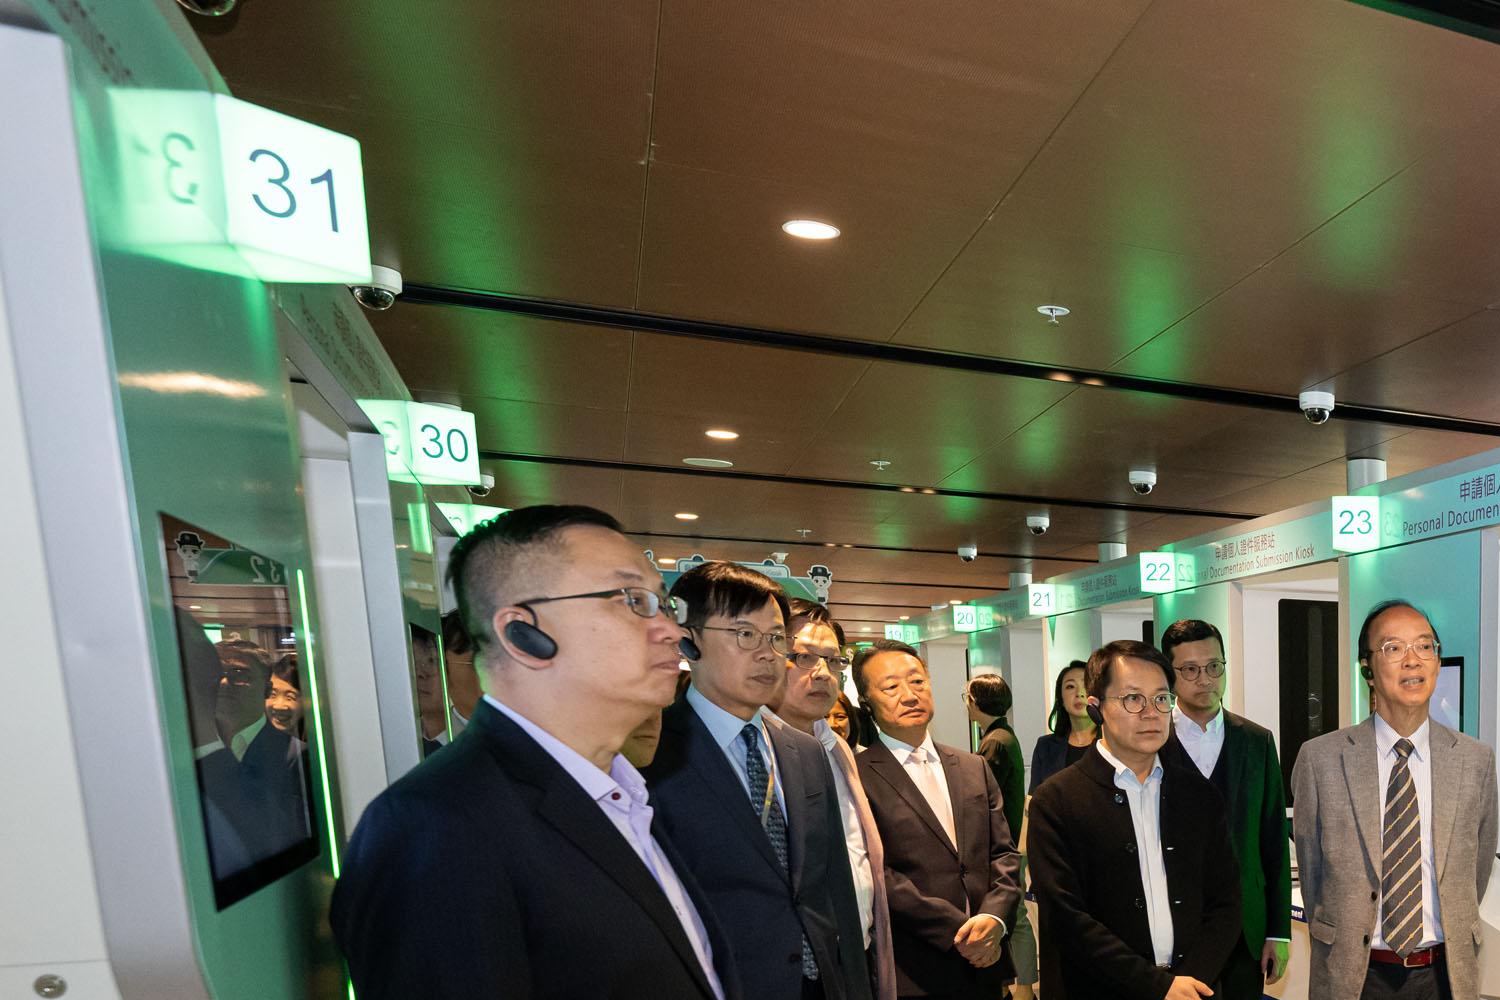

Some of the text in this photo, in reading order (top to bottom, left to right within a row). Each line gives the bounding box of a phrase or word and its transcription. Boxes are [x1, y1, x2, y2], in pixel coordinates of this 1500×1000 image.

[249, 148, 339, 233] 31
[421, 423, 469, 463] 30
[1338, 509, 1373, 535] 23
[1403, 512, 1444, 537] Personal
[1146, 562, 1171, 581] 22
[1210, 559, 1254, 579] Documentation
[1256, 550, 1294, 569] Submission
[1295, 543, 1315, 560] Kiosk
[1032, 591, 1050, 607] 21
[957, 612, 974, 625] 20
